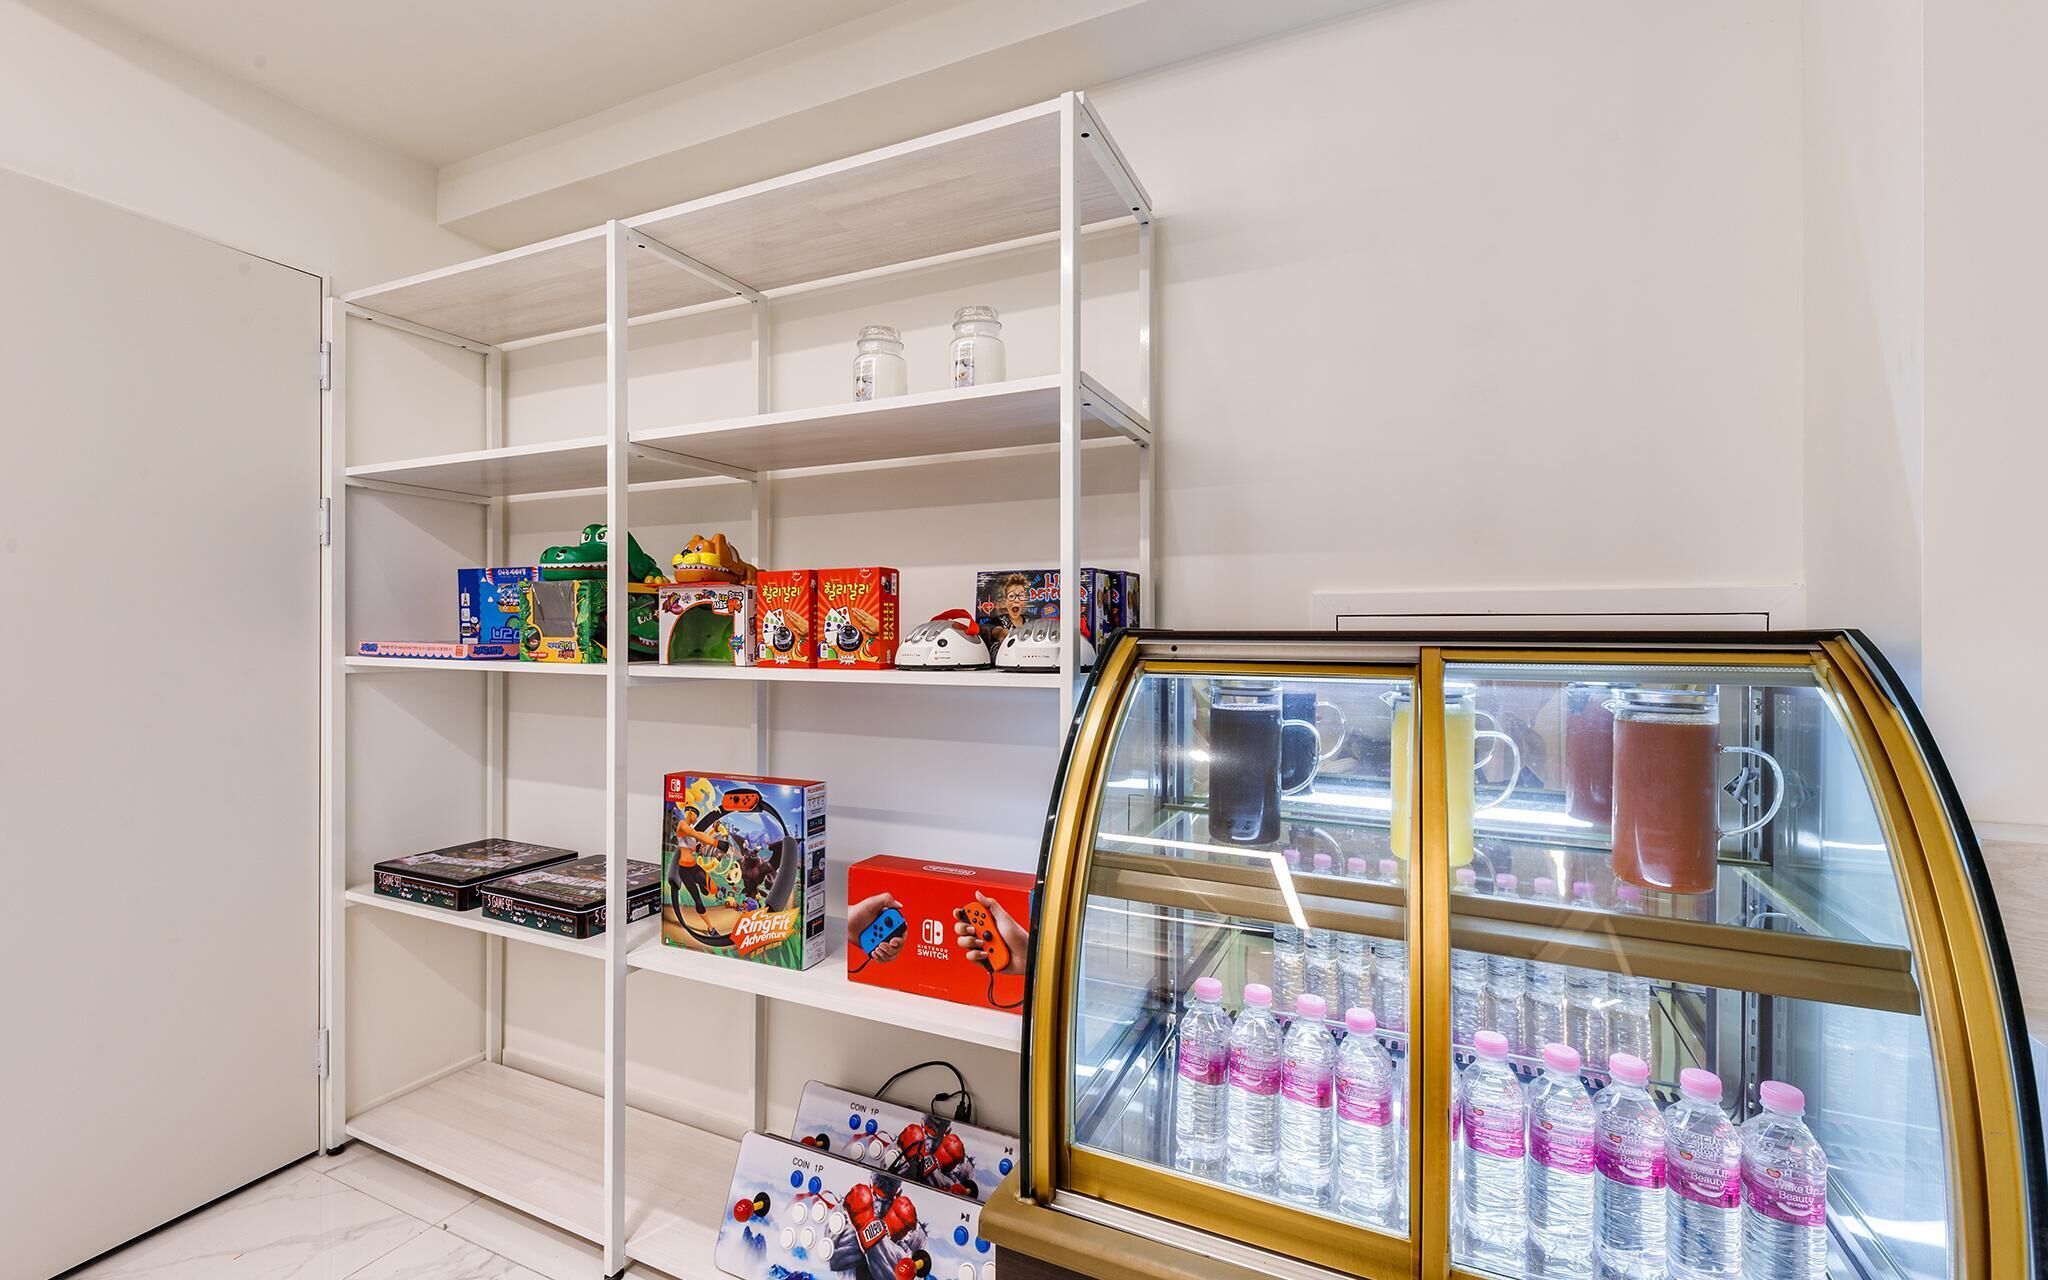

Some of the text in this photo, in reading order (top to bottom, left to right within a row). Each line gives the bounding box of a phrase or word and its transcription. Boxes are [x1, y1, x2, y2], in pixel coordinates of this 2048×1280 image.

[762, 584, 801, 603] 할리갈리
[823, 581, 870, 601] 할리갈리
[740, 931, 788, 950] Adventure
[917, 948, 949, 961] SWITCH
[849, 1102, 880, 1116] COIN 1P
[791, 1157, 824, 1174] COIN 1P
[1691, 1171, 1726, 1188] Beauty
[1774, 1179, 1820, 1197] Wake Up
[1778, 1190, 1815, 1206] Beauty
